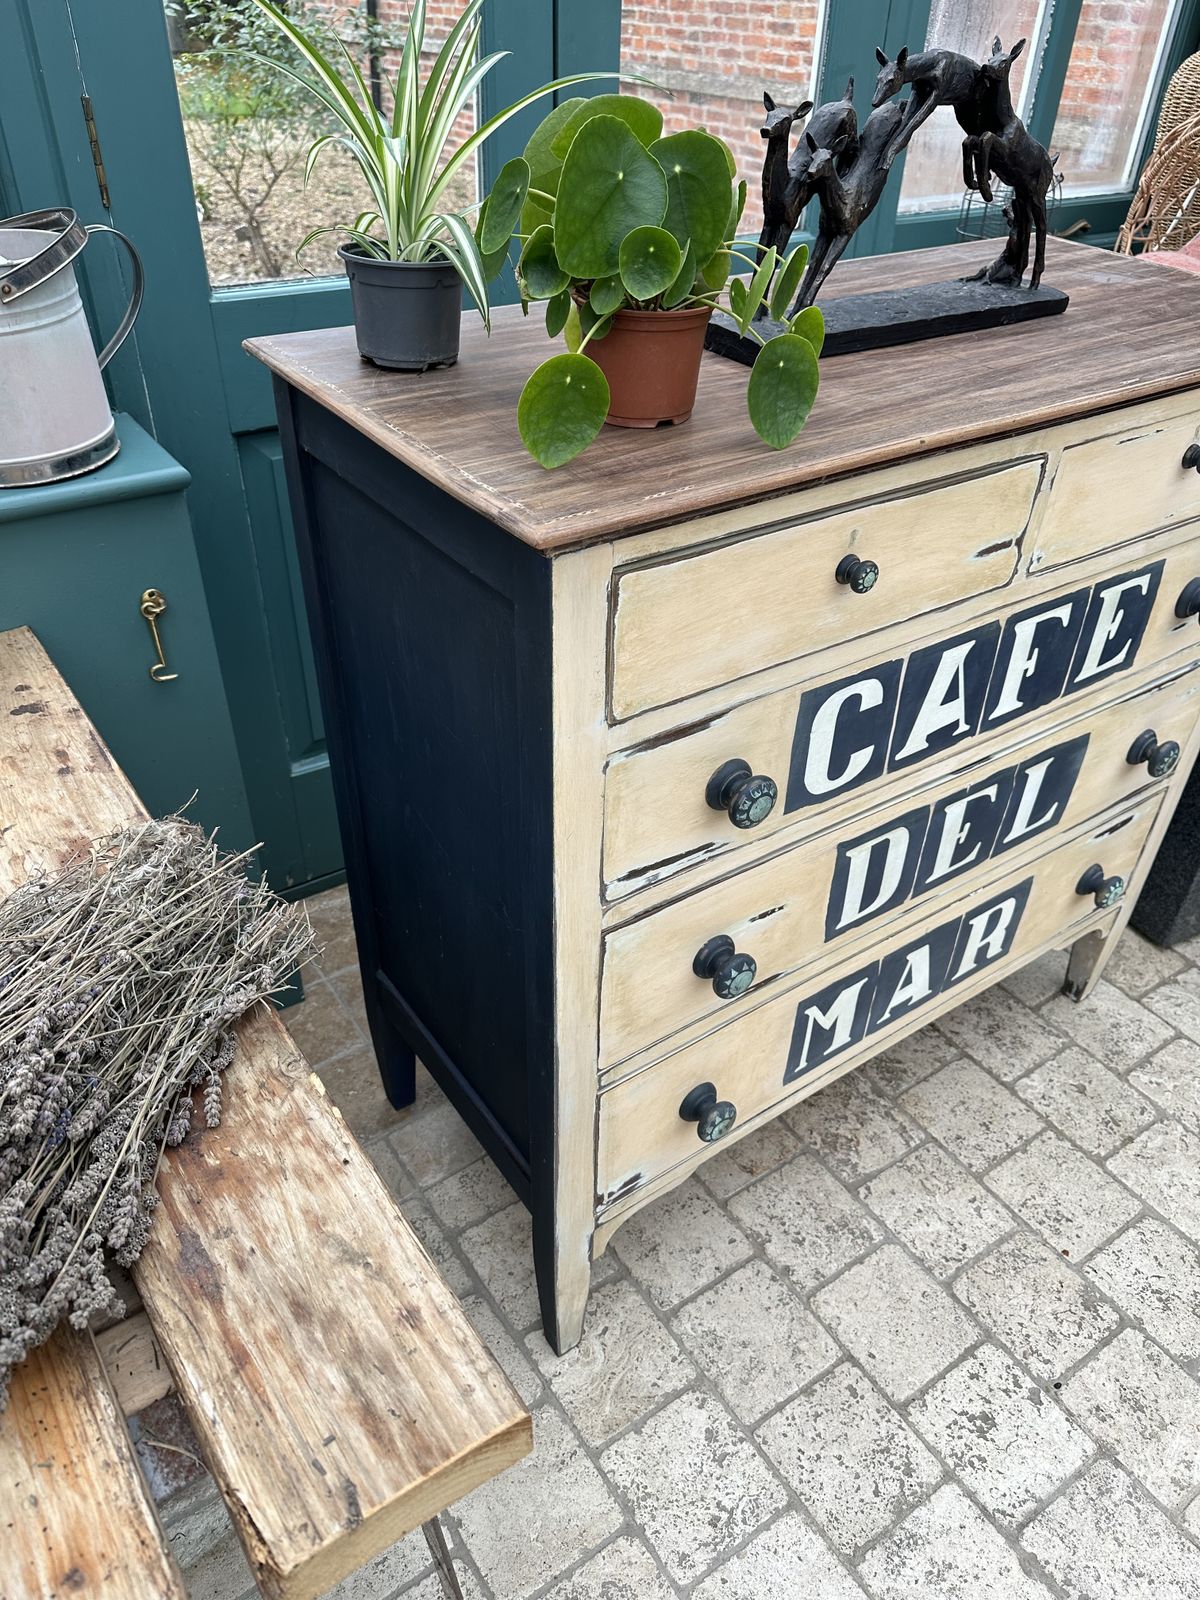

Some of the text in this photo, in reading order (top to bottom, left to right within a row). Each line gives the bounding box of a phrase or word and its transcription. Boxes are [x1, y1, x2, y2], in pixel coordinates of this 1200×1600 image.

[803, 574, 1149, 796] CAFE
[835, 757, 1059, 930] DEL
[795, 896, 1017, 1073] MAR
